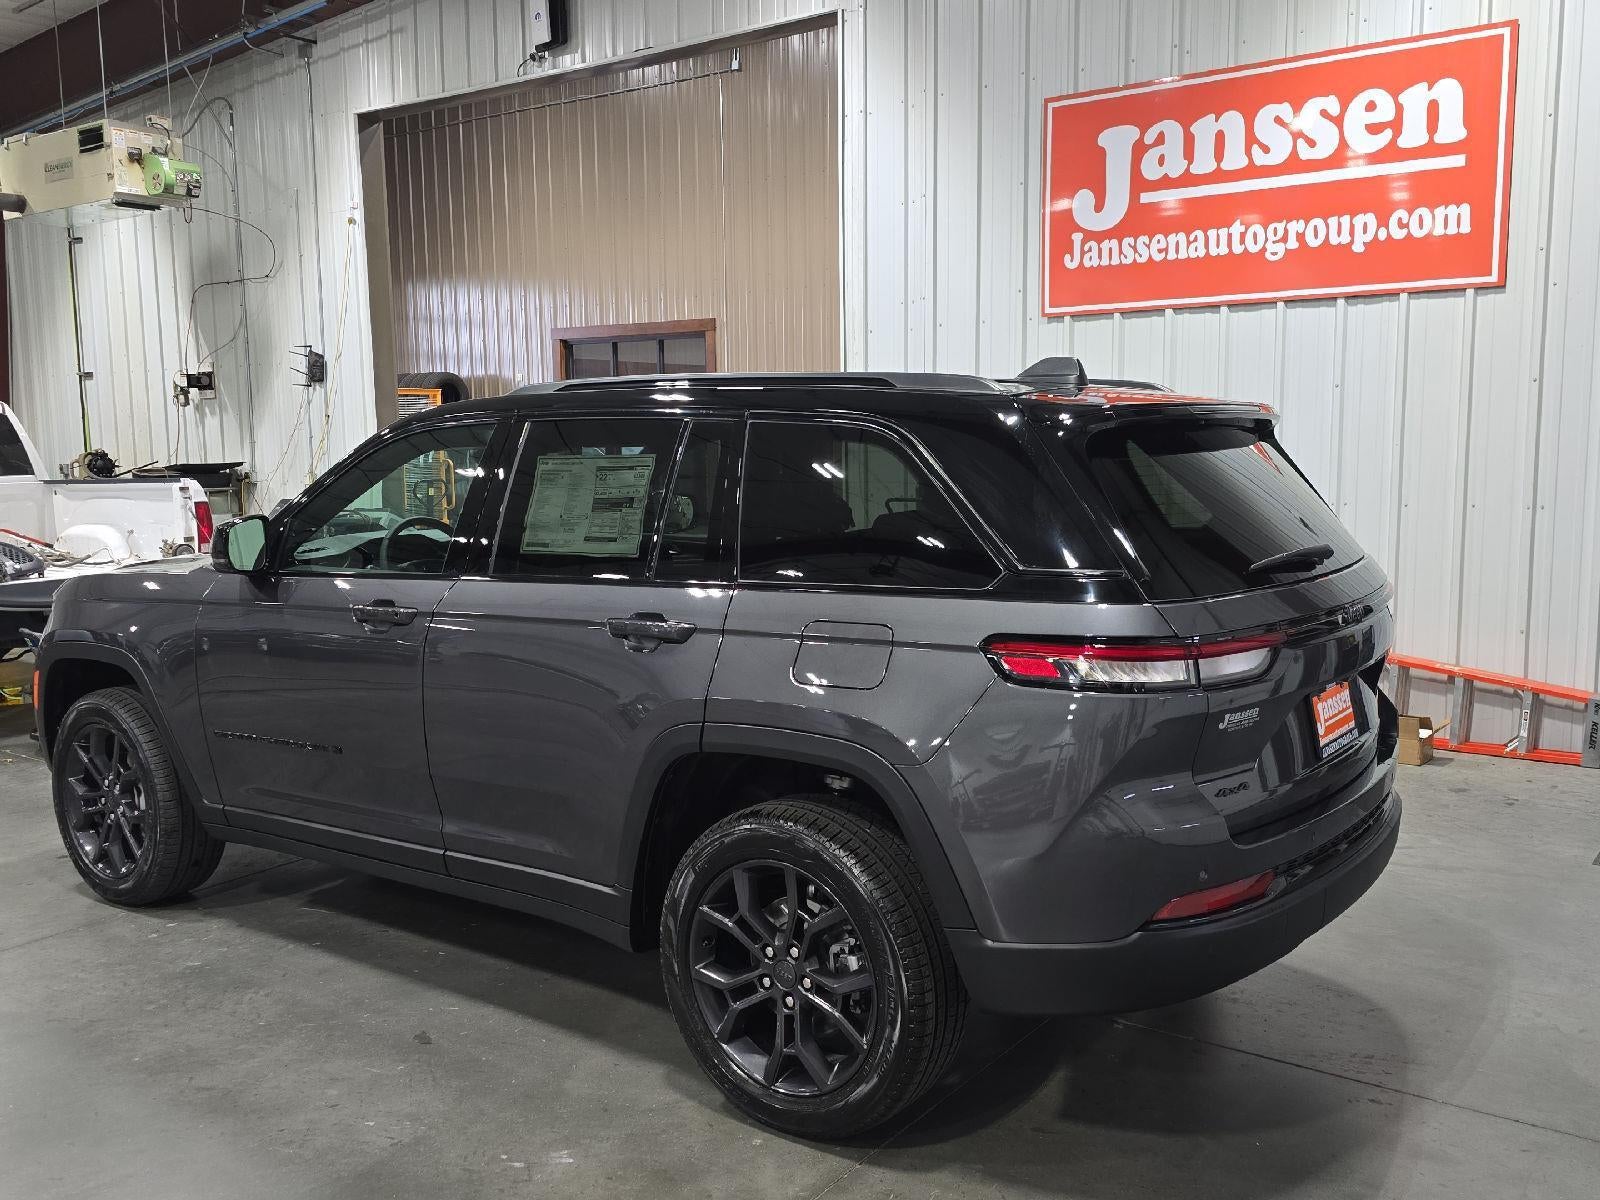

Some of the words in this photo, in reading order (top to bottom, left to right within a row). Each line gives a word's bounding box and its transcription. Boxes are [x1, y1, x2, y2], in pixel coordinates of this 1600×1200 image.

[1072, 77, 1467, 231] Janssen
[1063, 202, 1471, 269] Janssenautogroup.com
[1219, 708, 1259, 730] Janssen
[1317, 688, 1352, 735] Janssen
[1589, 721, 1599, 750] KELLER
